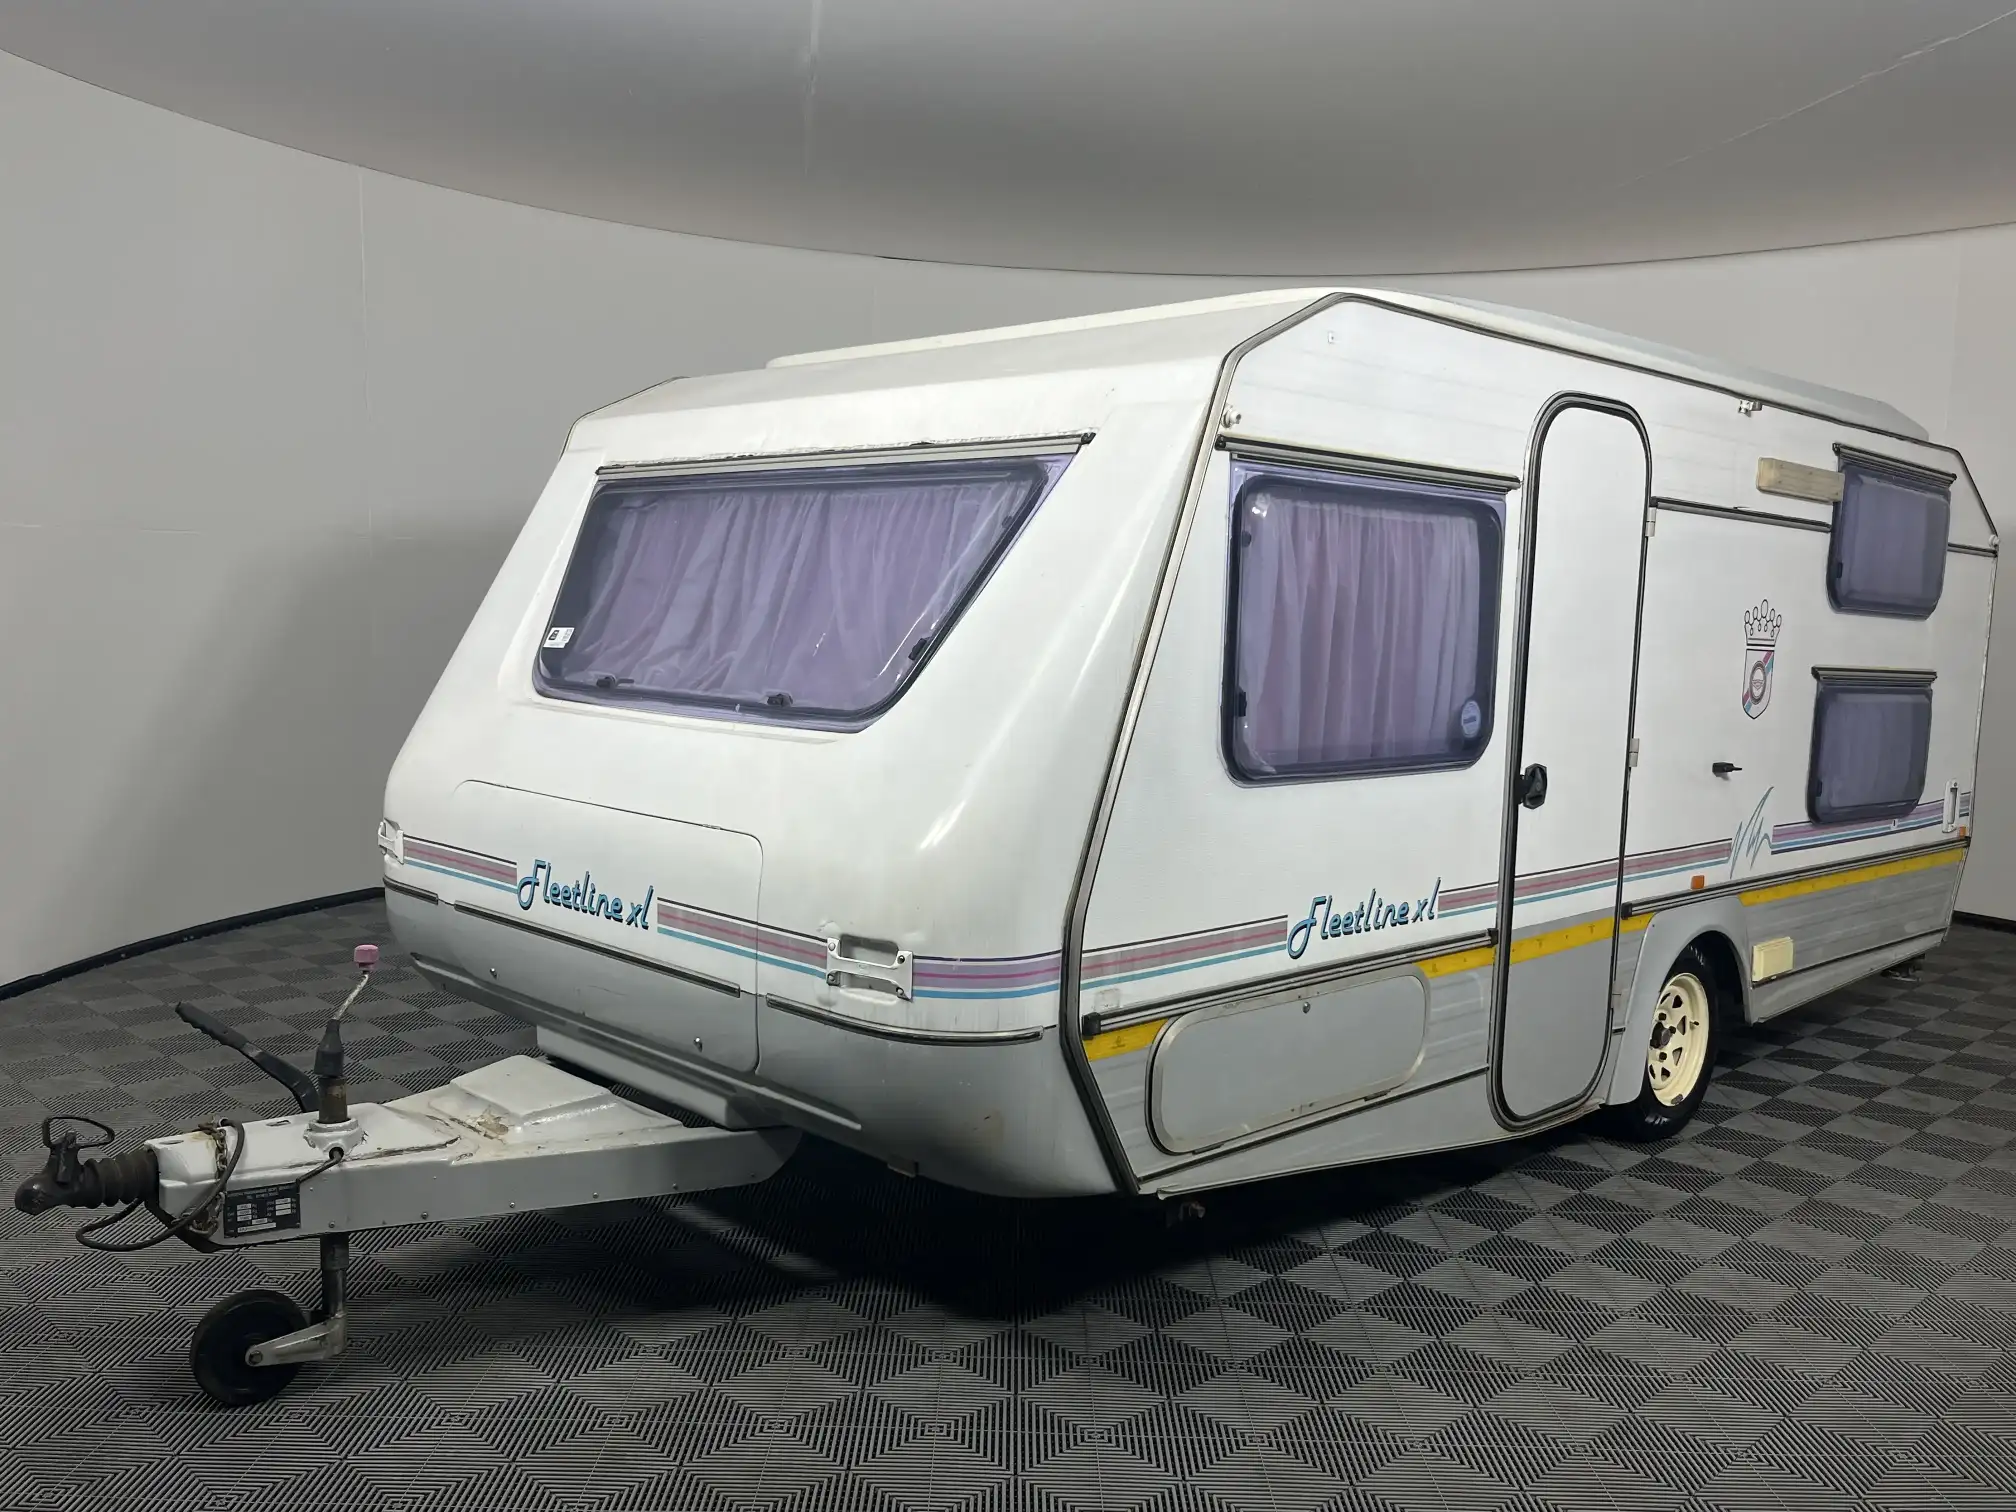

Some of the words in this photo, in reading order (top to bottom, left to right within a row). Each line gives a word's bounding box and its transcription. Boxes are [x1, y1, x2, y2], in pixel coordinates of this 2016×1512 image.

[517, 859, 623, 923] Fleetline
[626, 885, 654, 930] xl
[1287, 888, 1409, 959] Fleetline
[1411, 876, 1441, 923] xl
